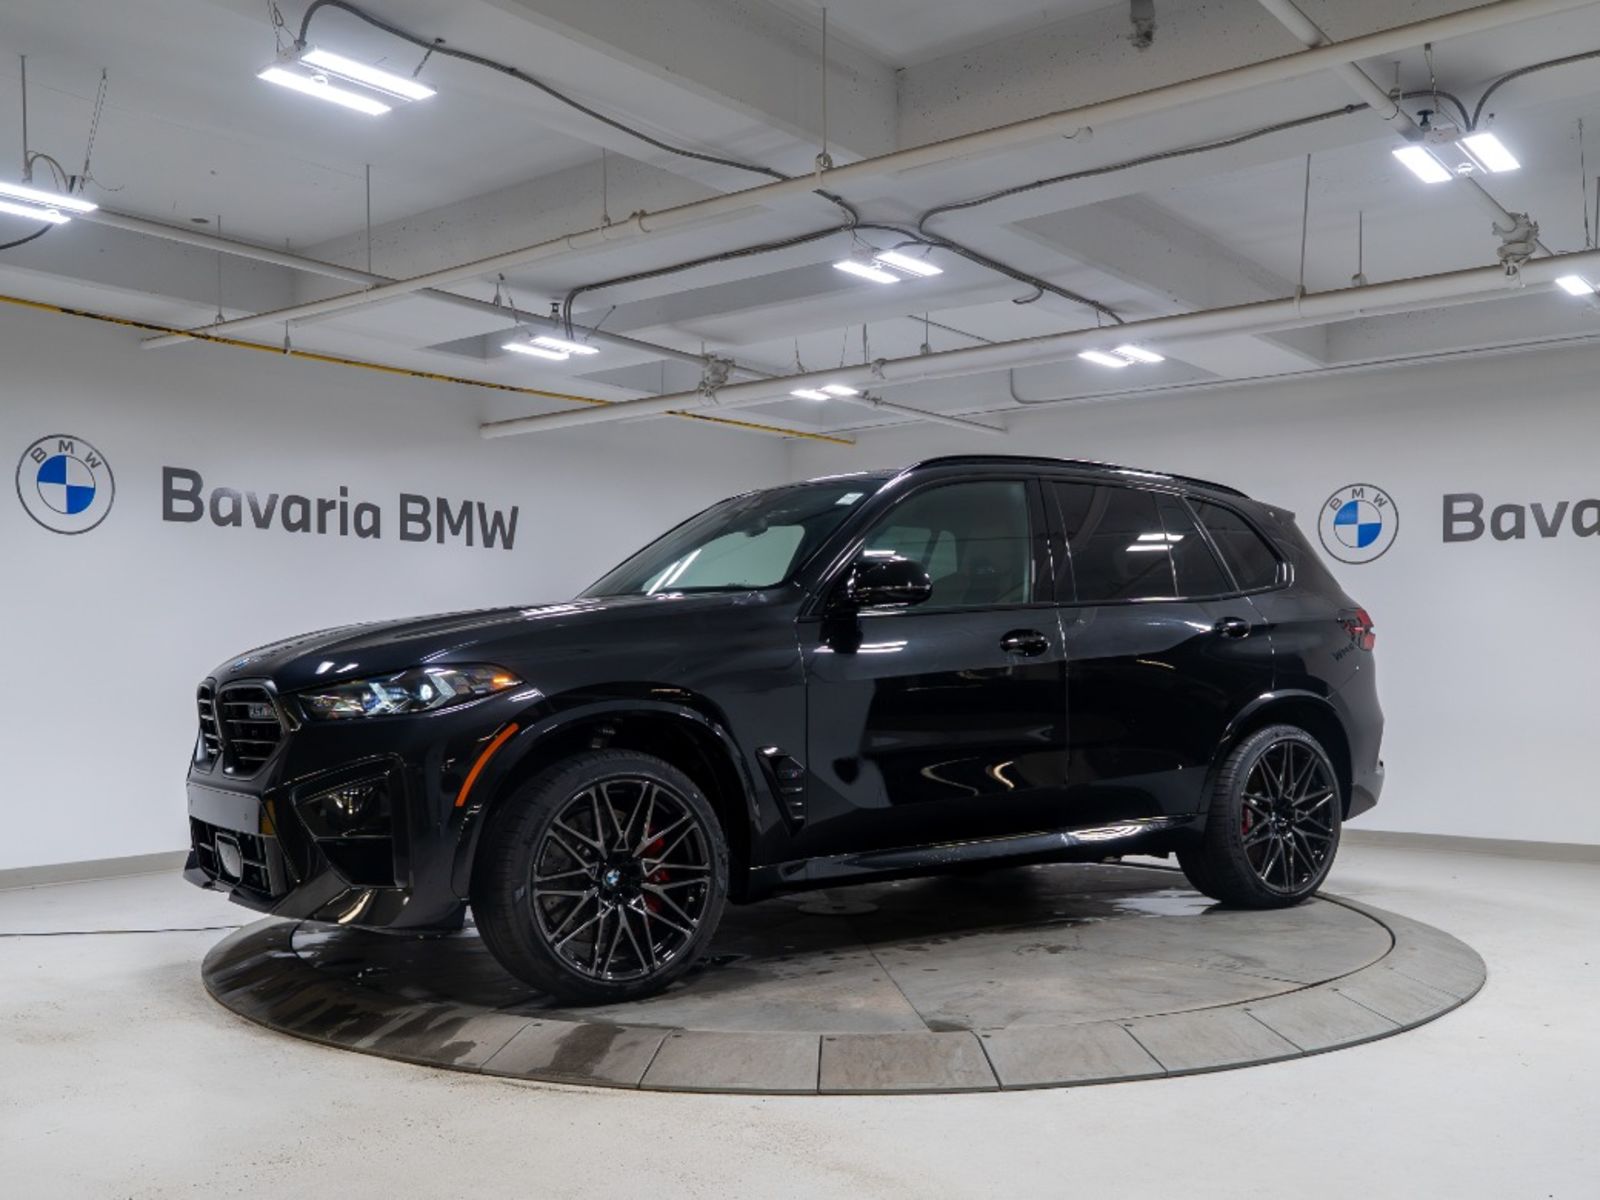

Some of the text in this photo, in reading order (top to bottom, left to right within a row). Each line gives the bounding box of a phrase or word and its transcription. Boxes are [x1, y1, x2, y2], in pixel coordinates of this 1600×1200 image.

[30, 439, 103, 470] BMW
[161, 465, 520, 552] Bavaria BMW
[1329, 487, 1388, 511] BMW
[1442, 492, 1600, 544] Bava
